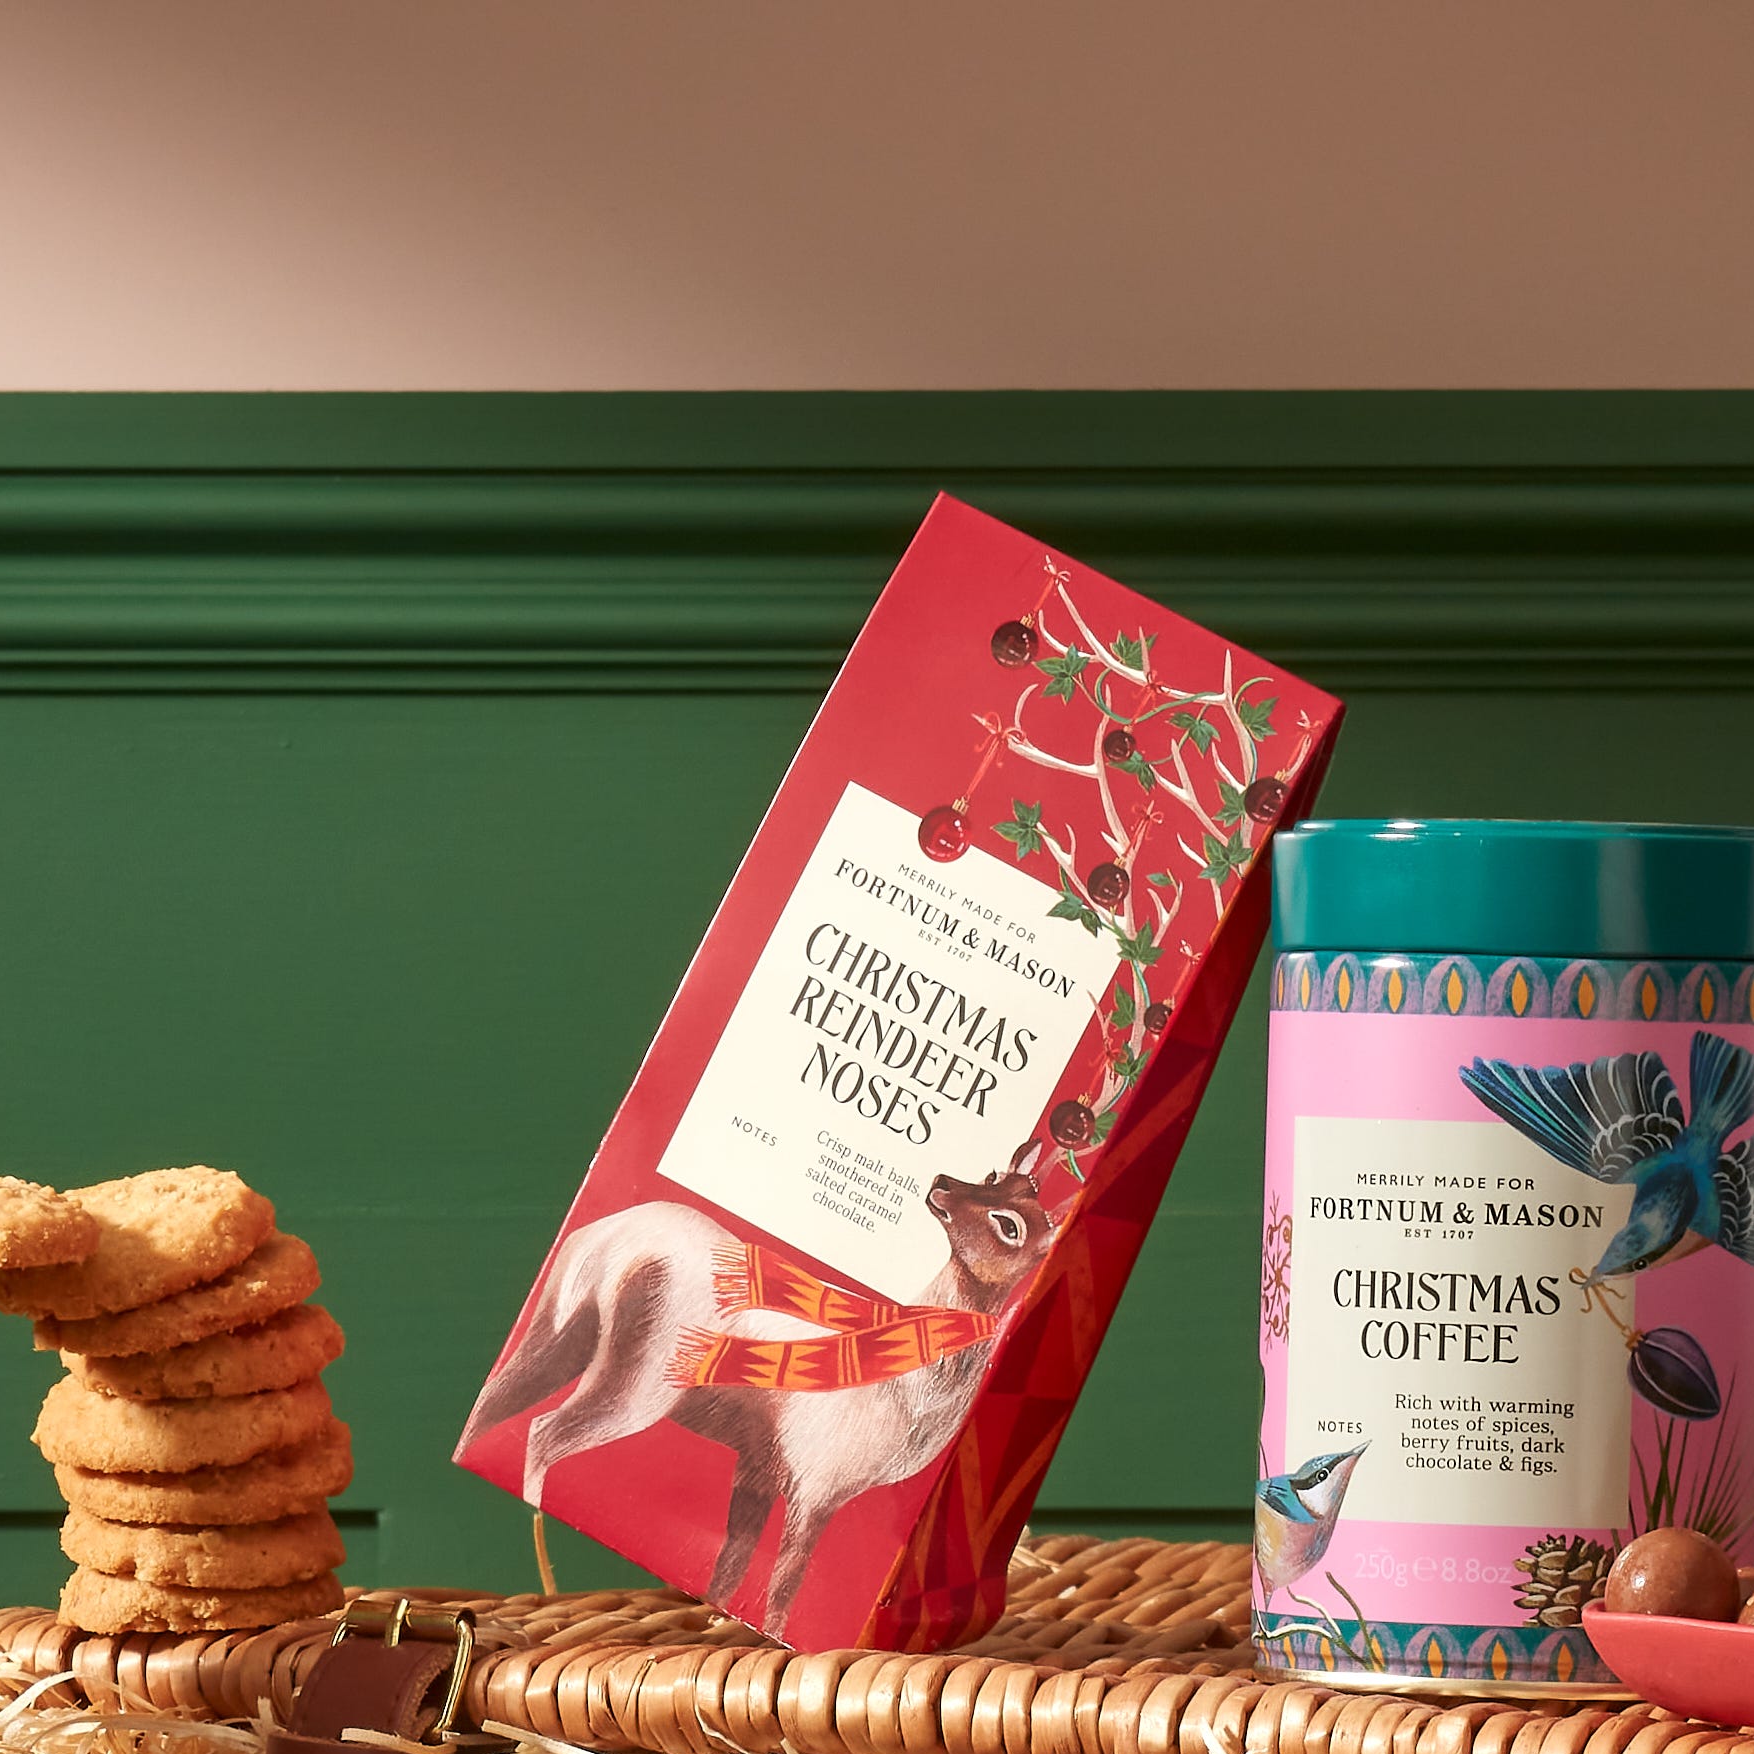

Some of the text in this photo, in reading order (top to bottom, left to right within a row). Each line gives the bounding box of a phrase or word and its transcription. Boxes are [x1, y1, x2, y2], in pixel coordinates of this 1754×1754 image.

[834, 858, 1076, 999] FORTNUM & MASON
[805, 923, 1038, 1072] CHRISTMAS
[789, 975, 998, 1118] REINDEER
[800, 1042, 941, 1145] NOSES
[731, 1116, 776, 1147] NOTES
[817, 1131, 920, 1197] Crisp malt balls,
[1357, 1173, 1535, 1191] MERRILY MADE FOR
[1310, 1196, 1605, 1228] FORTNUM & MASON
[1404, 1228, 1474, 1240] EST 1707
[1333, 1268, 1561, 1316] CHRISTMAS
[1360, 1319, 1520, 1364] COFFEE
[1395, 1393, 1575, 1420] Rich with warming
[1411, 1415, 1555, 1436] notes of spices,
[1317, 1420, 1363, 1434] NOTES
